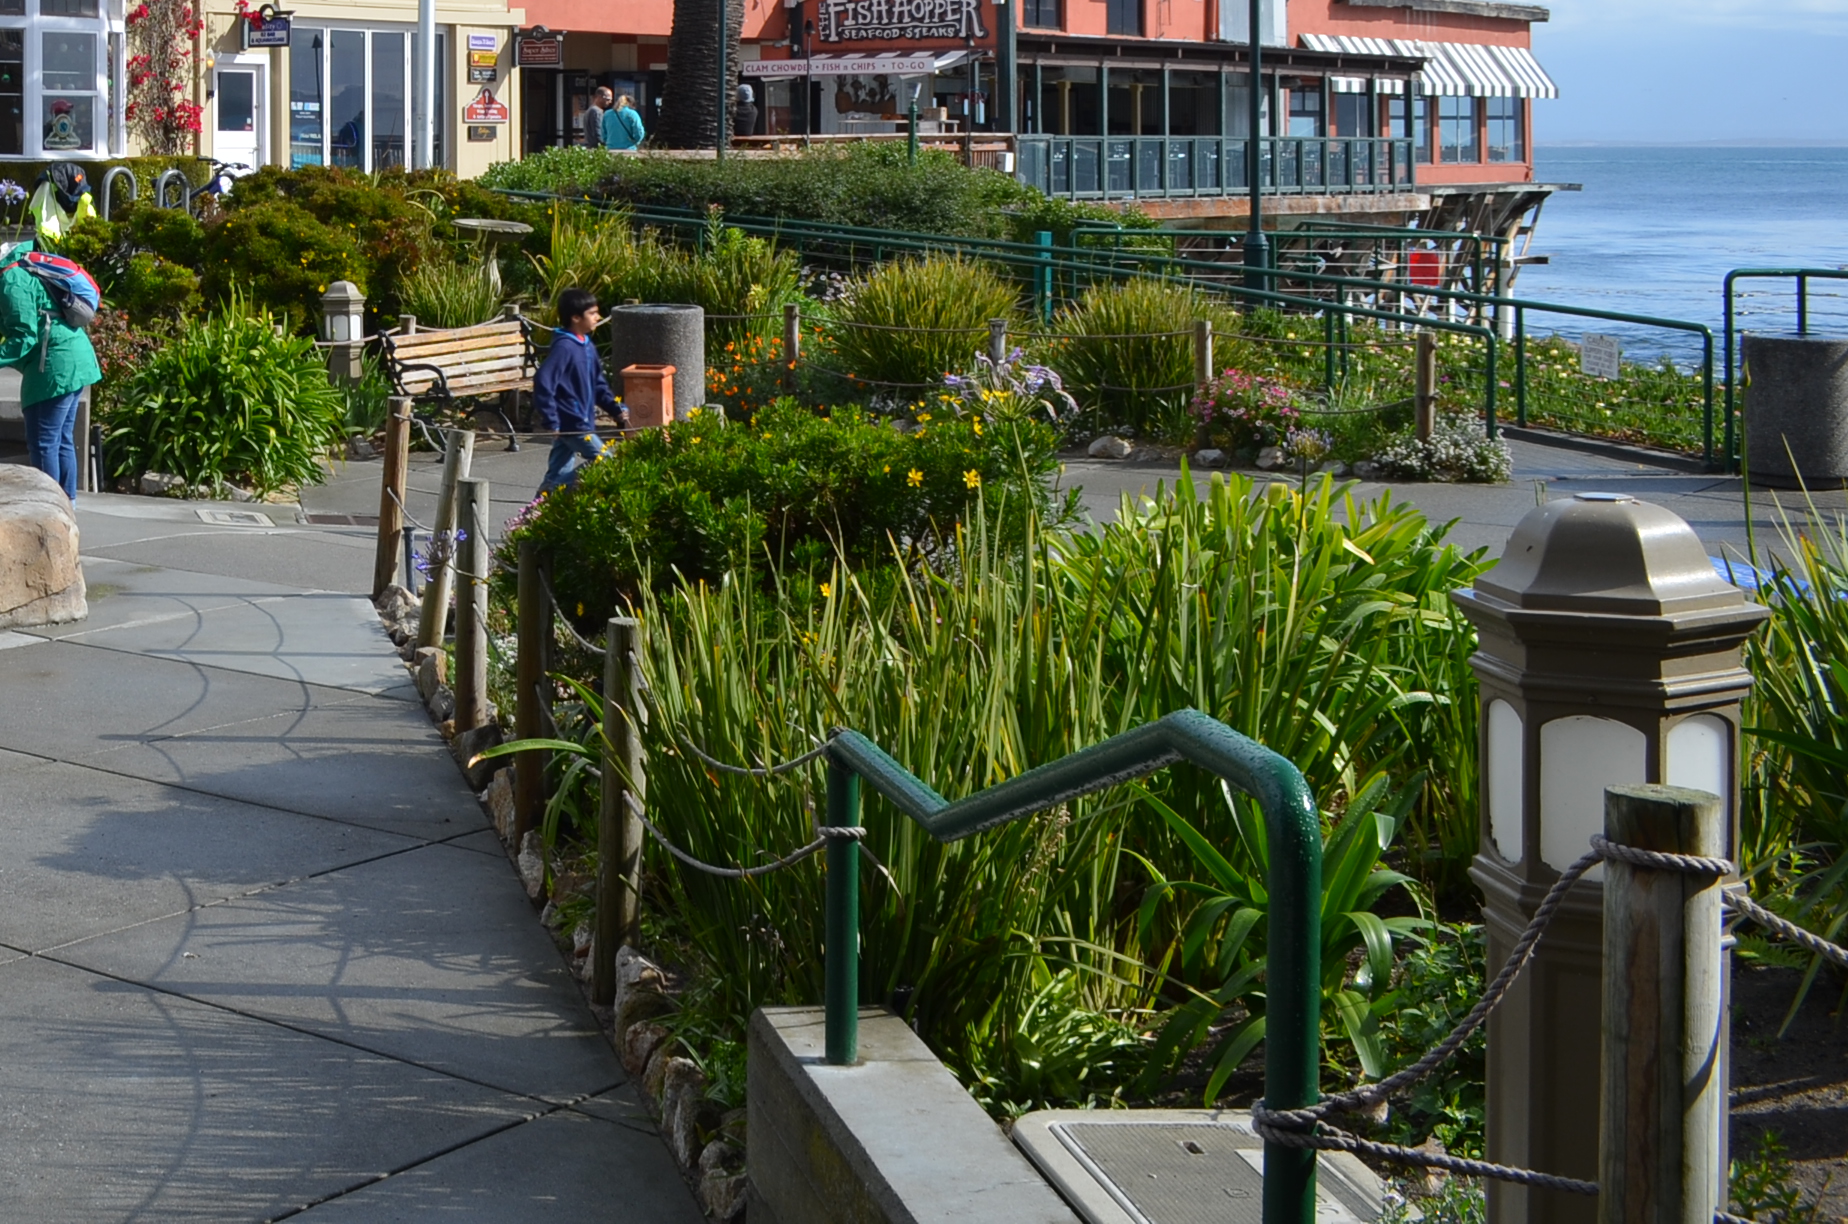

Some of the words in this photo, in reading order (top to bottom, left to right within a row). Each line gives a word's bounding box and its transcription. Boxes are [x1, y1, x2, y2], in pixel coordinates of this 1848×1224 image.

[818, 2, 830, 41] THE
[843, 27, 901, 40] SEAFOOD
[905, 26, 956, 38] STEAKS
[745, 64, 769, 73] CLAM
[822, 63, 841, 71] FISH
[851, 62, 876, 71] CHIPS
[891, 61, 925, 70] TO-GO
[1586, 336, 1614, 348] CAUTION
